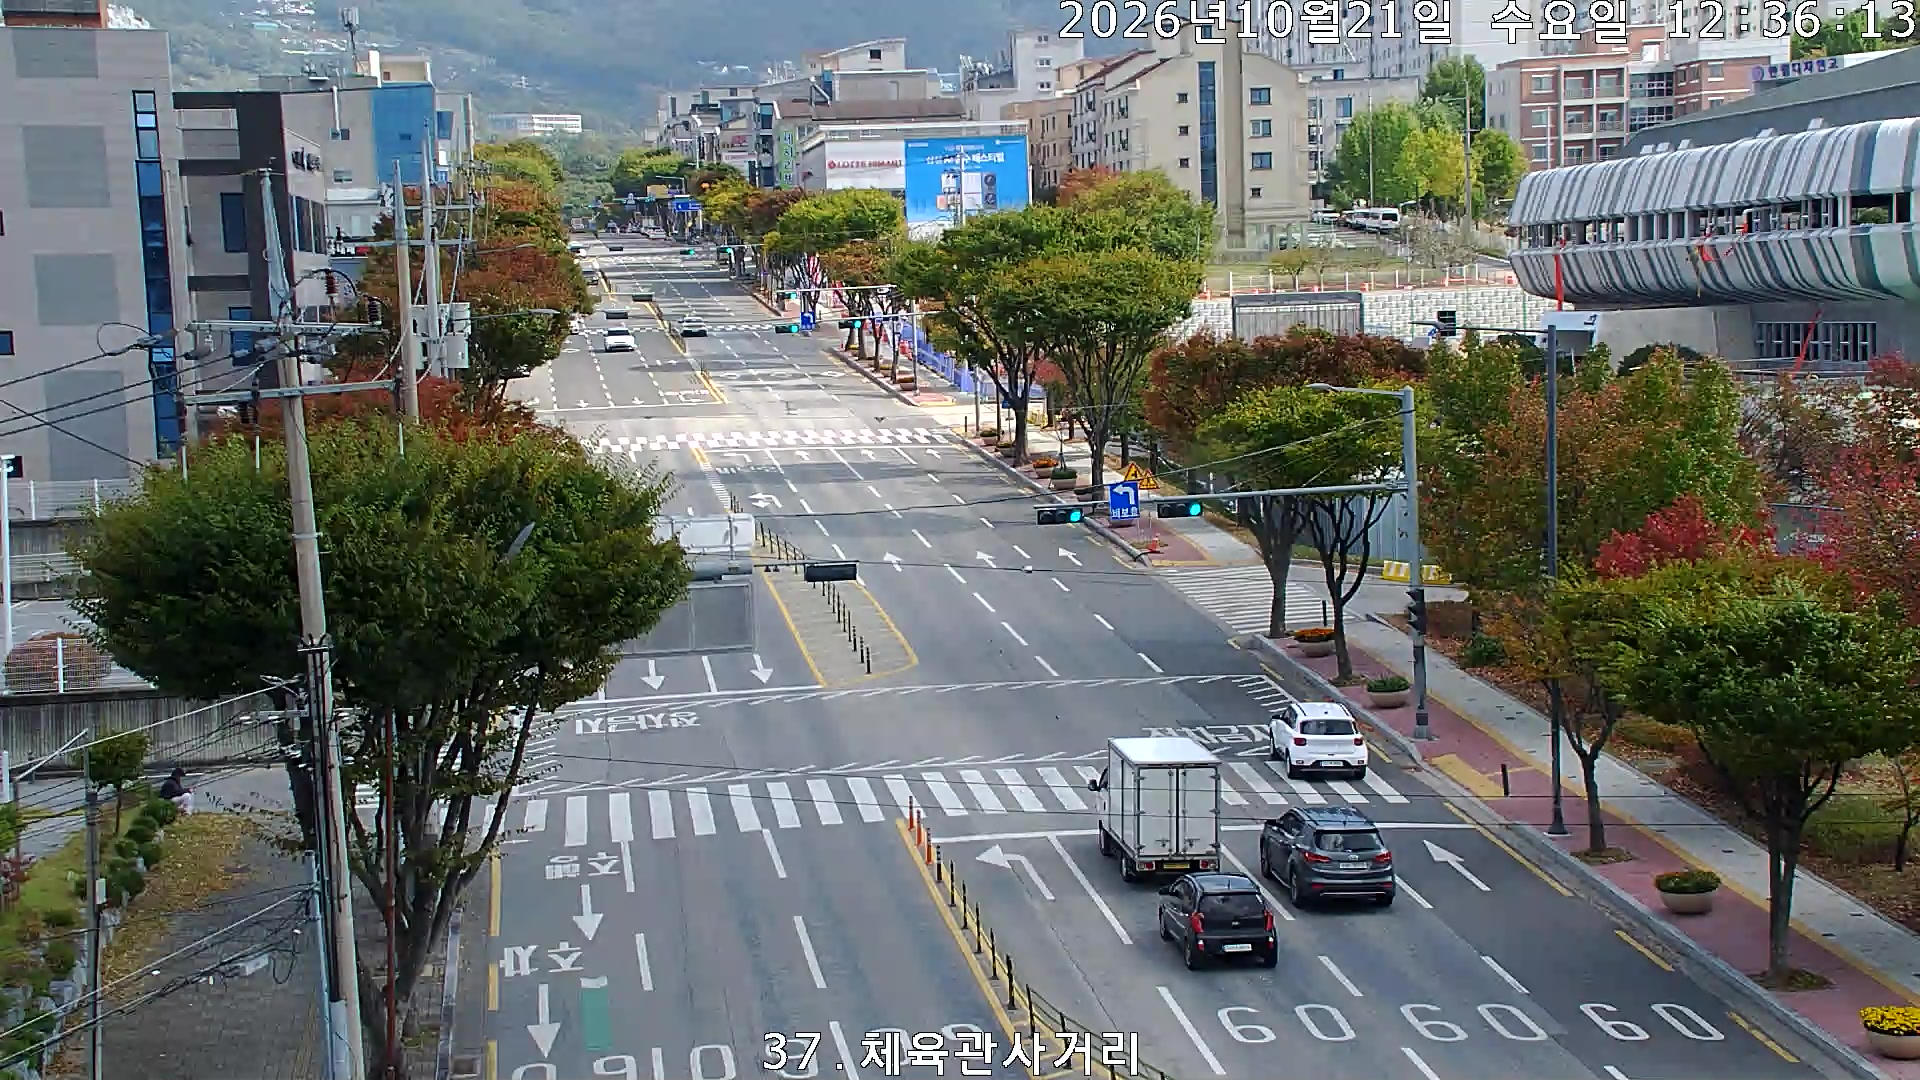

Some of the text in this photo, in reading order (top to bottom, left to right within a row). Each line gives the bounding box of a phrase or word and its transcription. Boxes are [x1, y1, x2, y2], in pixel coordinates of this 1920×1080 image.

[1112, 506, 1138, 519] 비보호
[499, 941, 585, 977] 주차
[1216, 1003, 1357, 1043] 60
[1399, 1003, 1549, 1042] 60
[1579, 1002, 1726, 1042] 60
